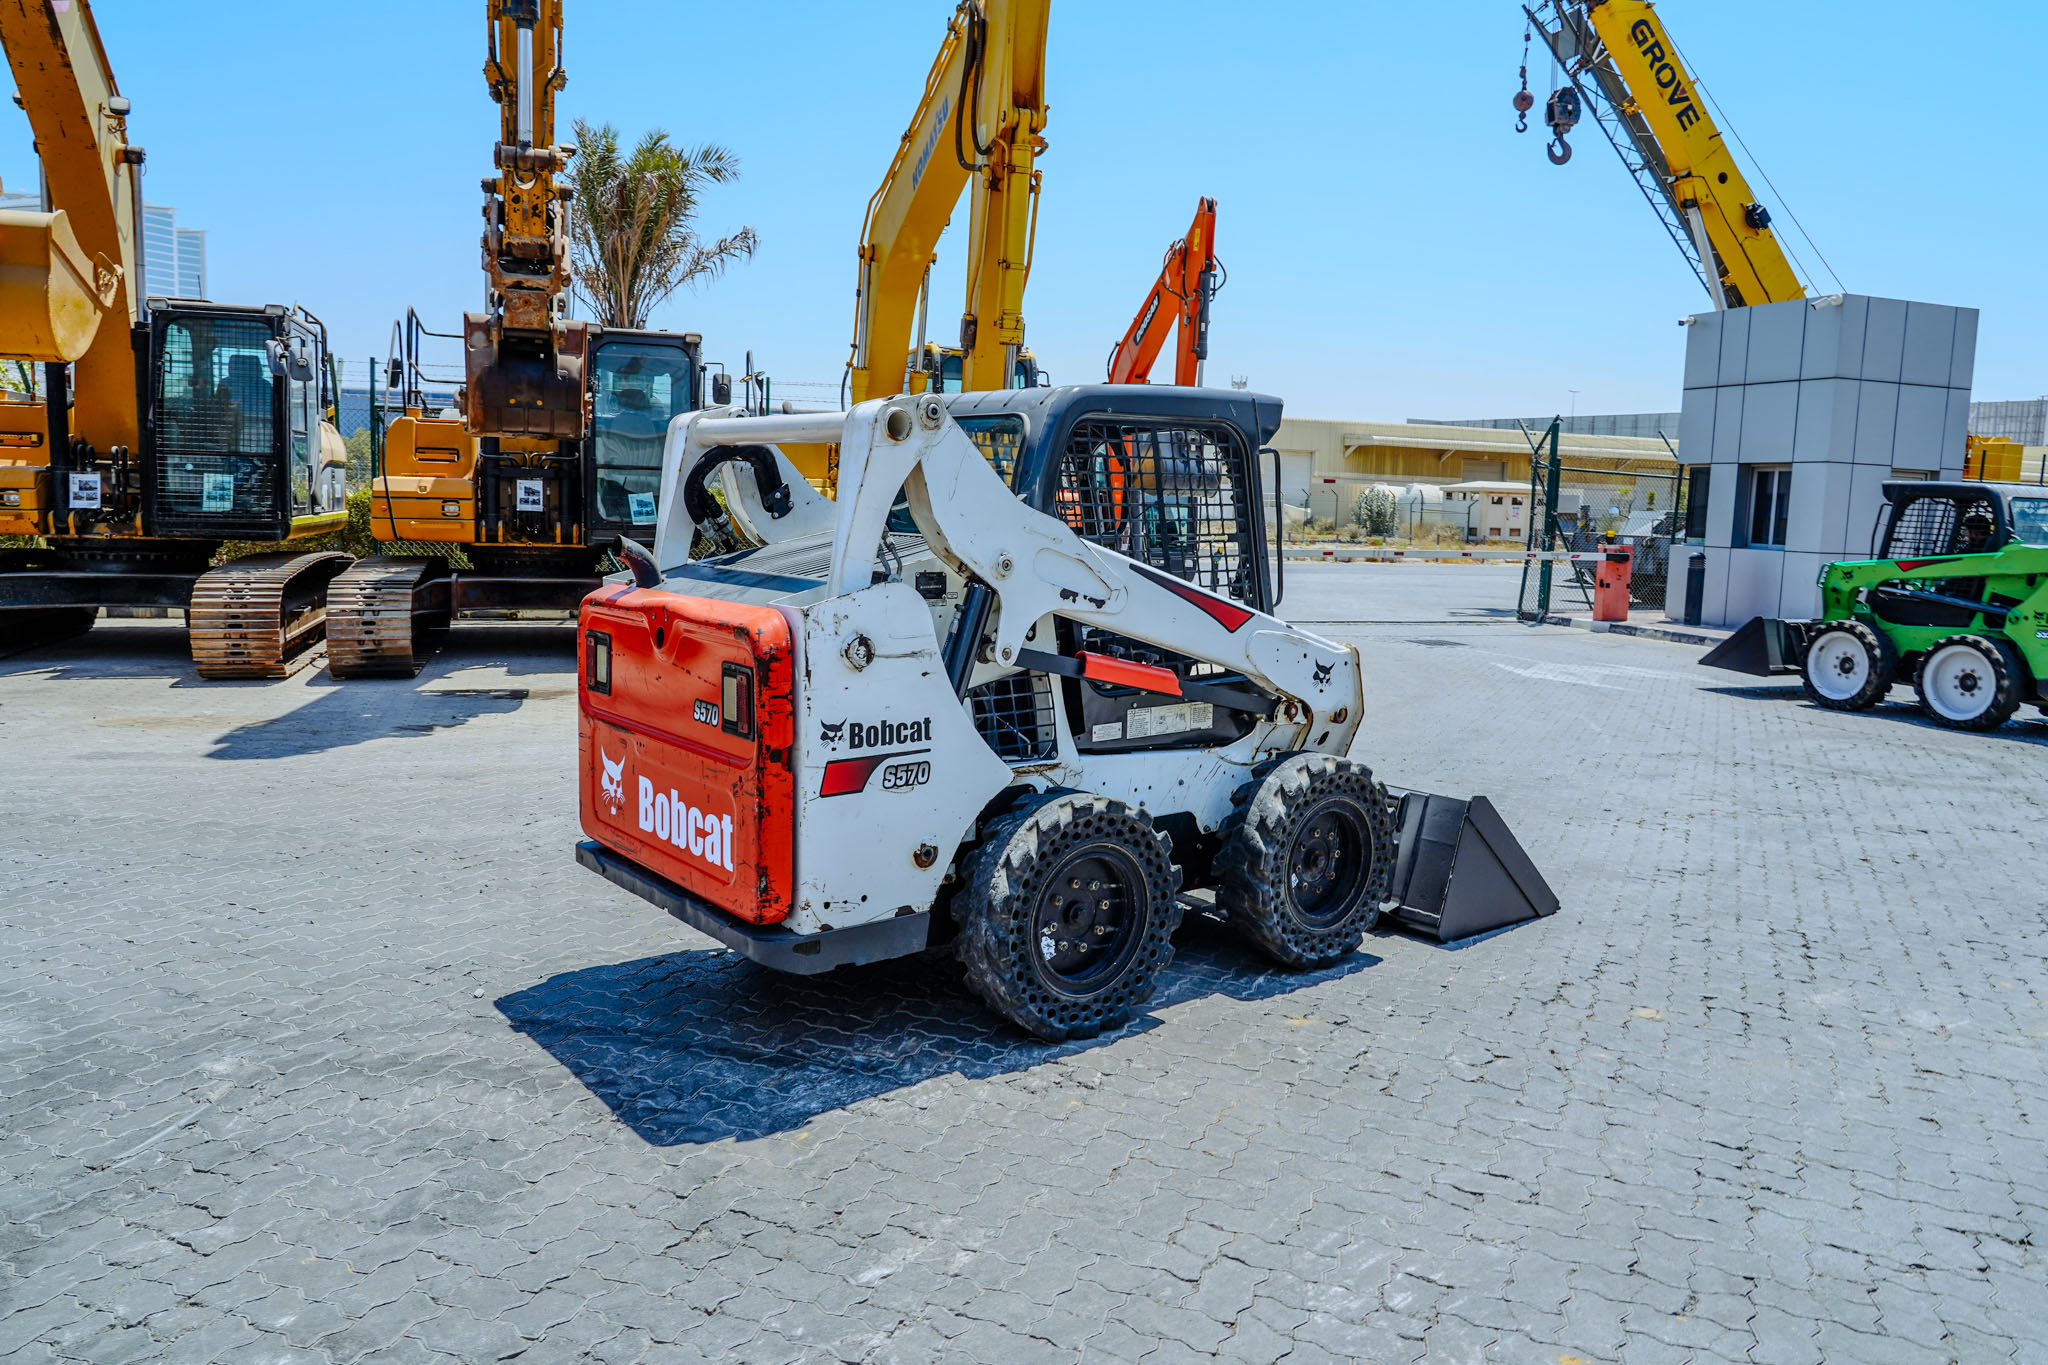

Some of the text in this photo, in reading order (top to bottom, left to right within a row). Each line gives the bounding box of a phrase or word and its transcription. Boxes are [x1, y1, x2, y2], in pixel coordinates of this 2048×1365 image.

[1631, 19, 1701, 132] GROVE
[912, 96, 949, 192] KOMATSU
[1136, 295, 1159, 343] DOOSAN
[693, 698, 719, 727] S570
[849, 717, 932, 750] Bobcat
[882, 761, 931, 790] S570
[638, 775, 733, 872] Bobcat
